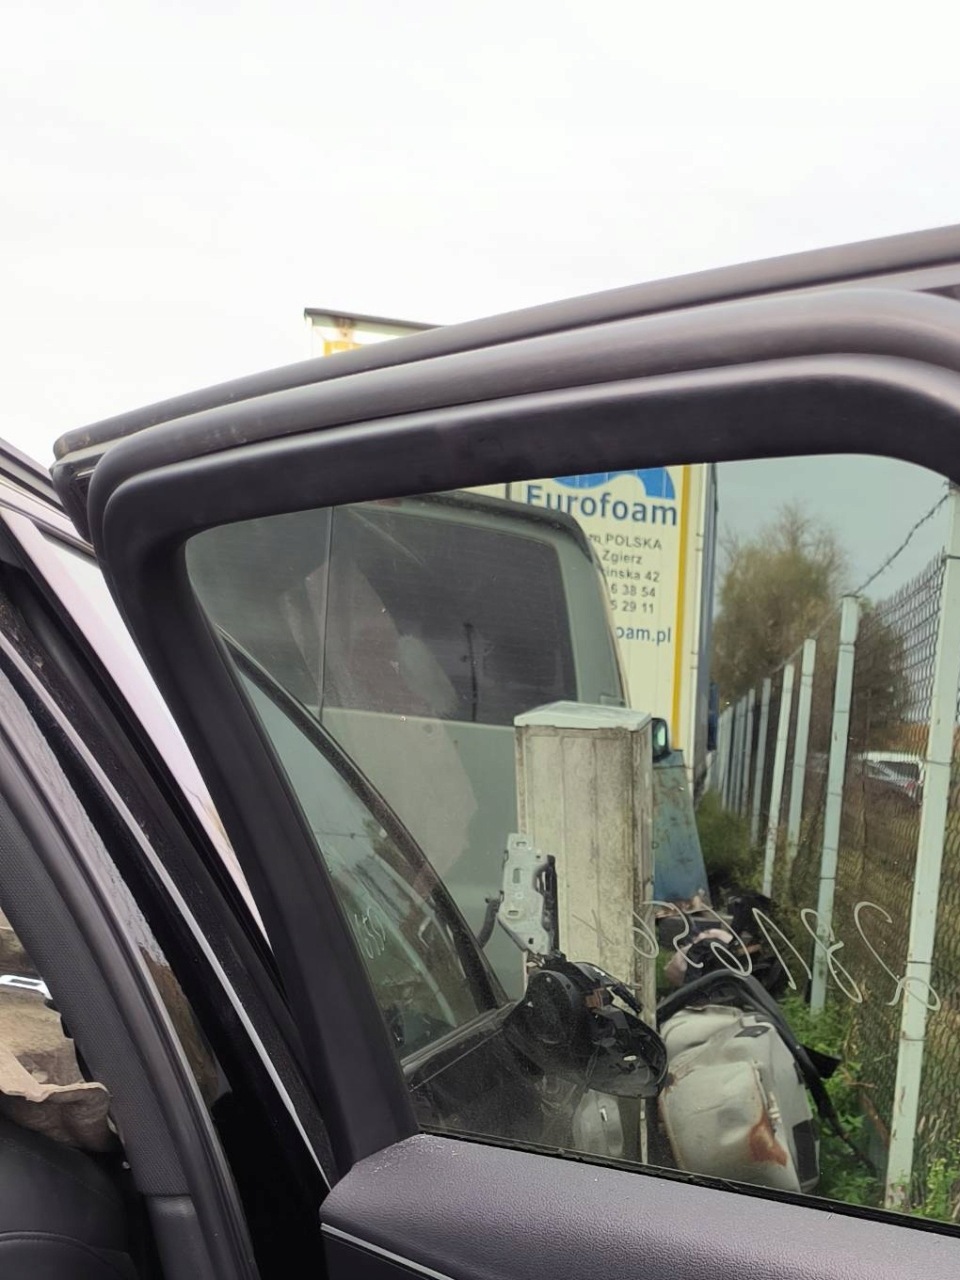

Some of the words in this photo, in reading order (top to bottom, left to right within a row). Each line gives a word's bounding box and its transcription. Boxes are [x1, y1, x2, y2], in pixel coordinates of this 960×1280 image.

[526, 484, 678, 526] Eurofoam
[605, 533, 663, 551] POLSKA
[602, 549, 643, 565] Zgierz
[602, 566, 641, 581] inska
[644, 570, 661, 584] 42
[622, 583, 637, 597] 38
[640, 585, 656, 598] 54
[621, 600, 637, 613] 29
[642, 602, 655, 614] 11
